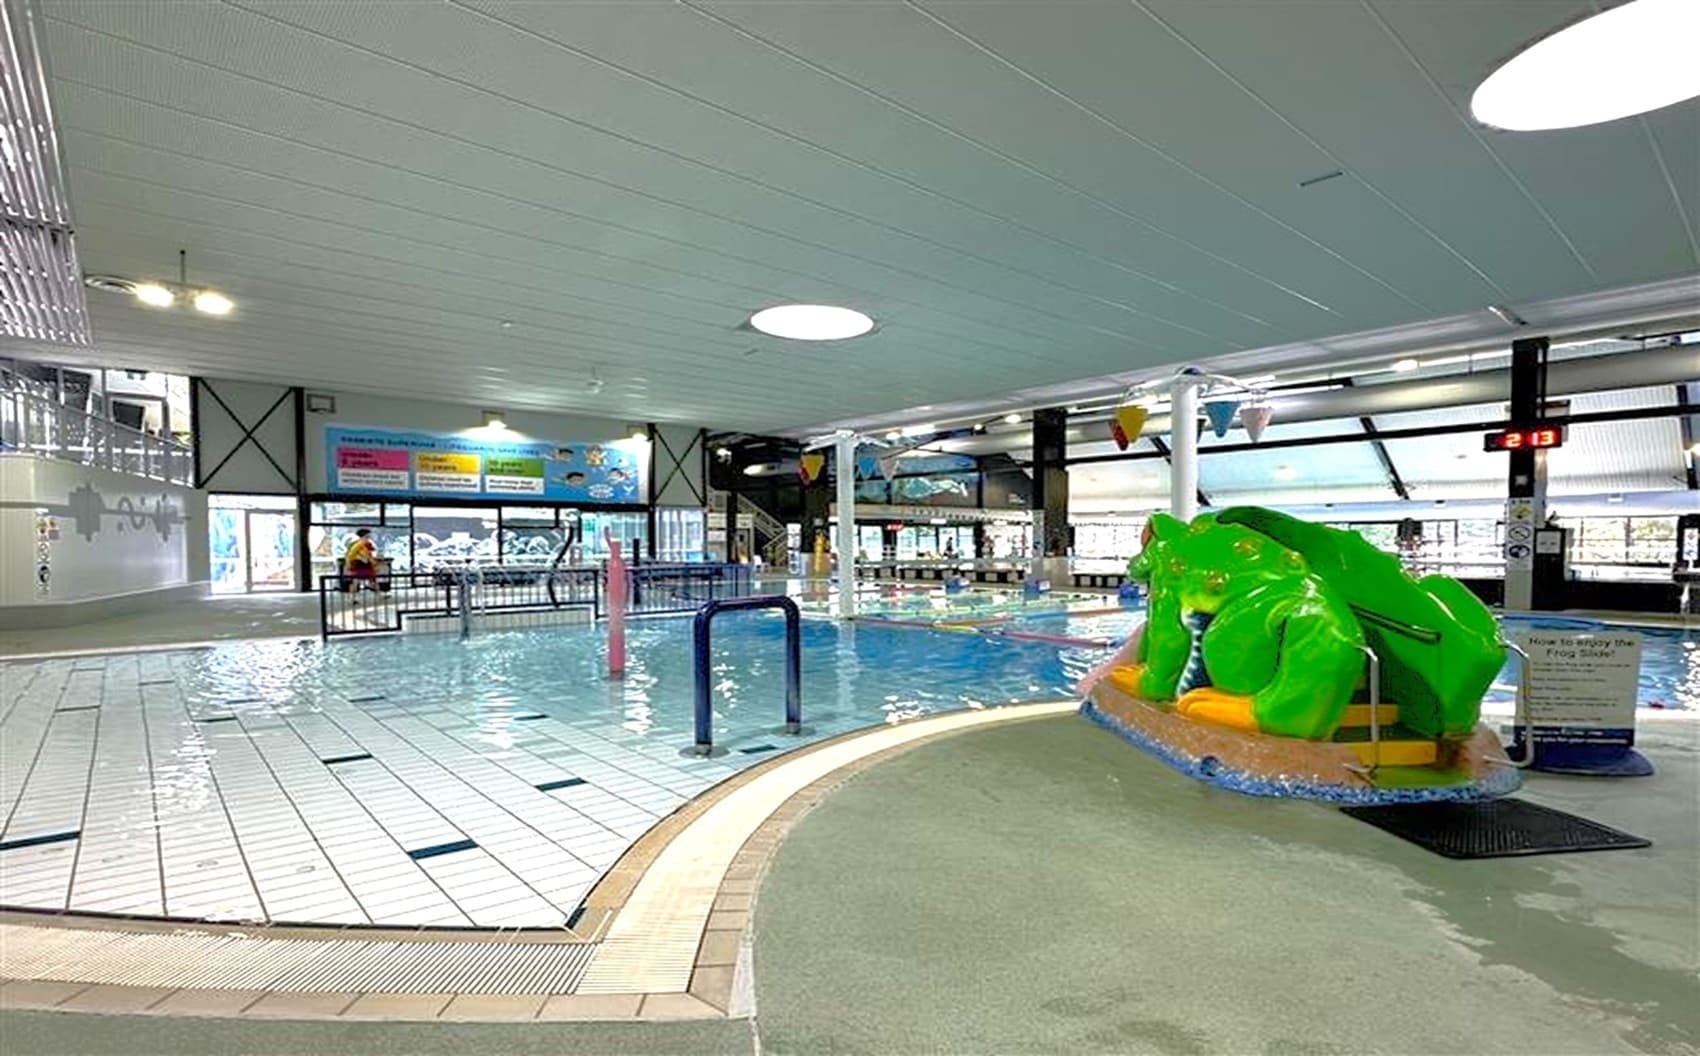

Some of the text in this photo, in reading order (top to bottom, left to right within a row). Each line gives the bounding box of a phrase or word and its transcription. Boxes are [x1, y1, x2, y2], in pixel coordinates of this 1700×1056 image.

[1529, 637, 1635, 649] How to enjoy the
[1546, 649, 1576, 659] Frog
